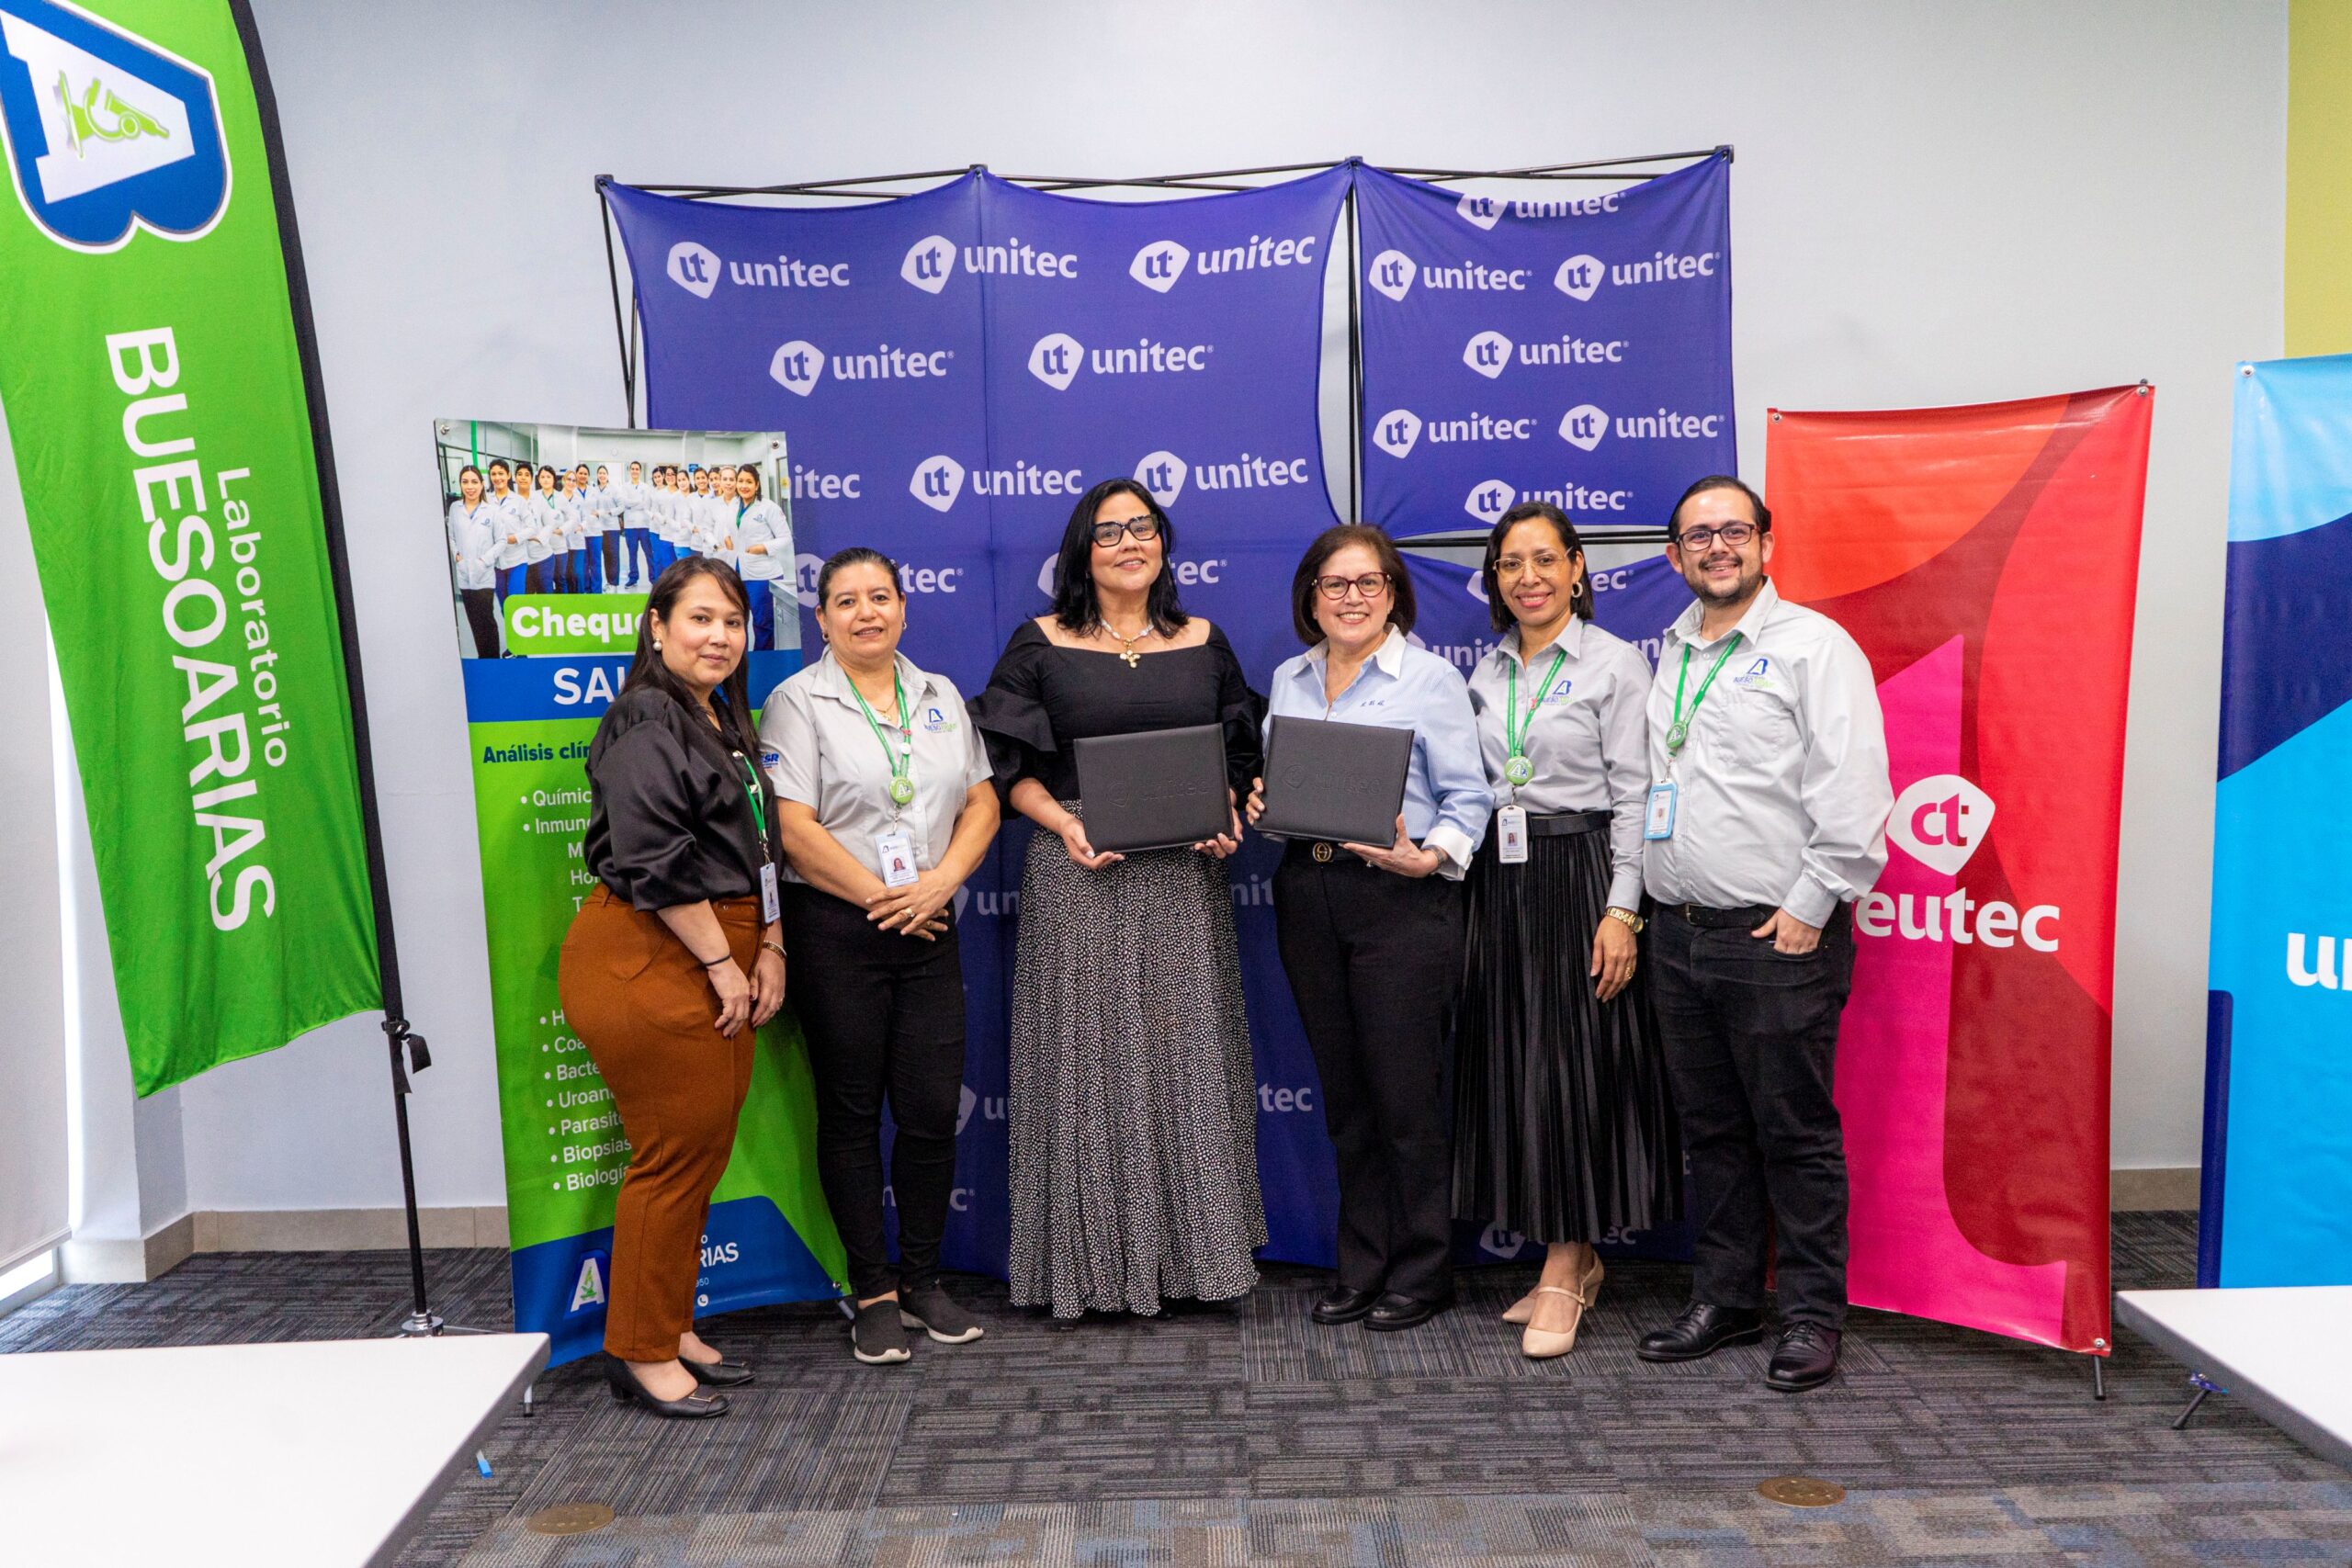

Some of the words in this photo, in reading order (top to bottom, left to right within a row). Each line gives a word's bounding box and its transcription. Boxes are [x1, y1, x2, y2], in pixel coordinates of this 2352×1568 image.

[791, 465, 861, 499] itec
[105, 326, 277, 931] BUESOARIAS
[217, 467, 287, 768] Laboratorio
[482, 742, 554, 763] Análisis
[533, 787, 593, 807] Químic
[1854, 886, 2060, 953] eutec
[557, 1060, 601, 1081] Bacte
[559, 1087, 616, 1109] Uroan
[563, 1137, 632, 1164] Biopsias
